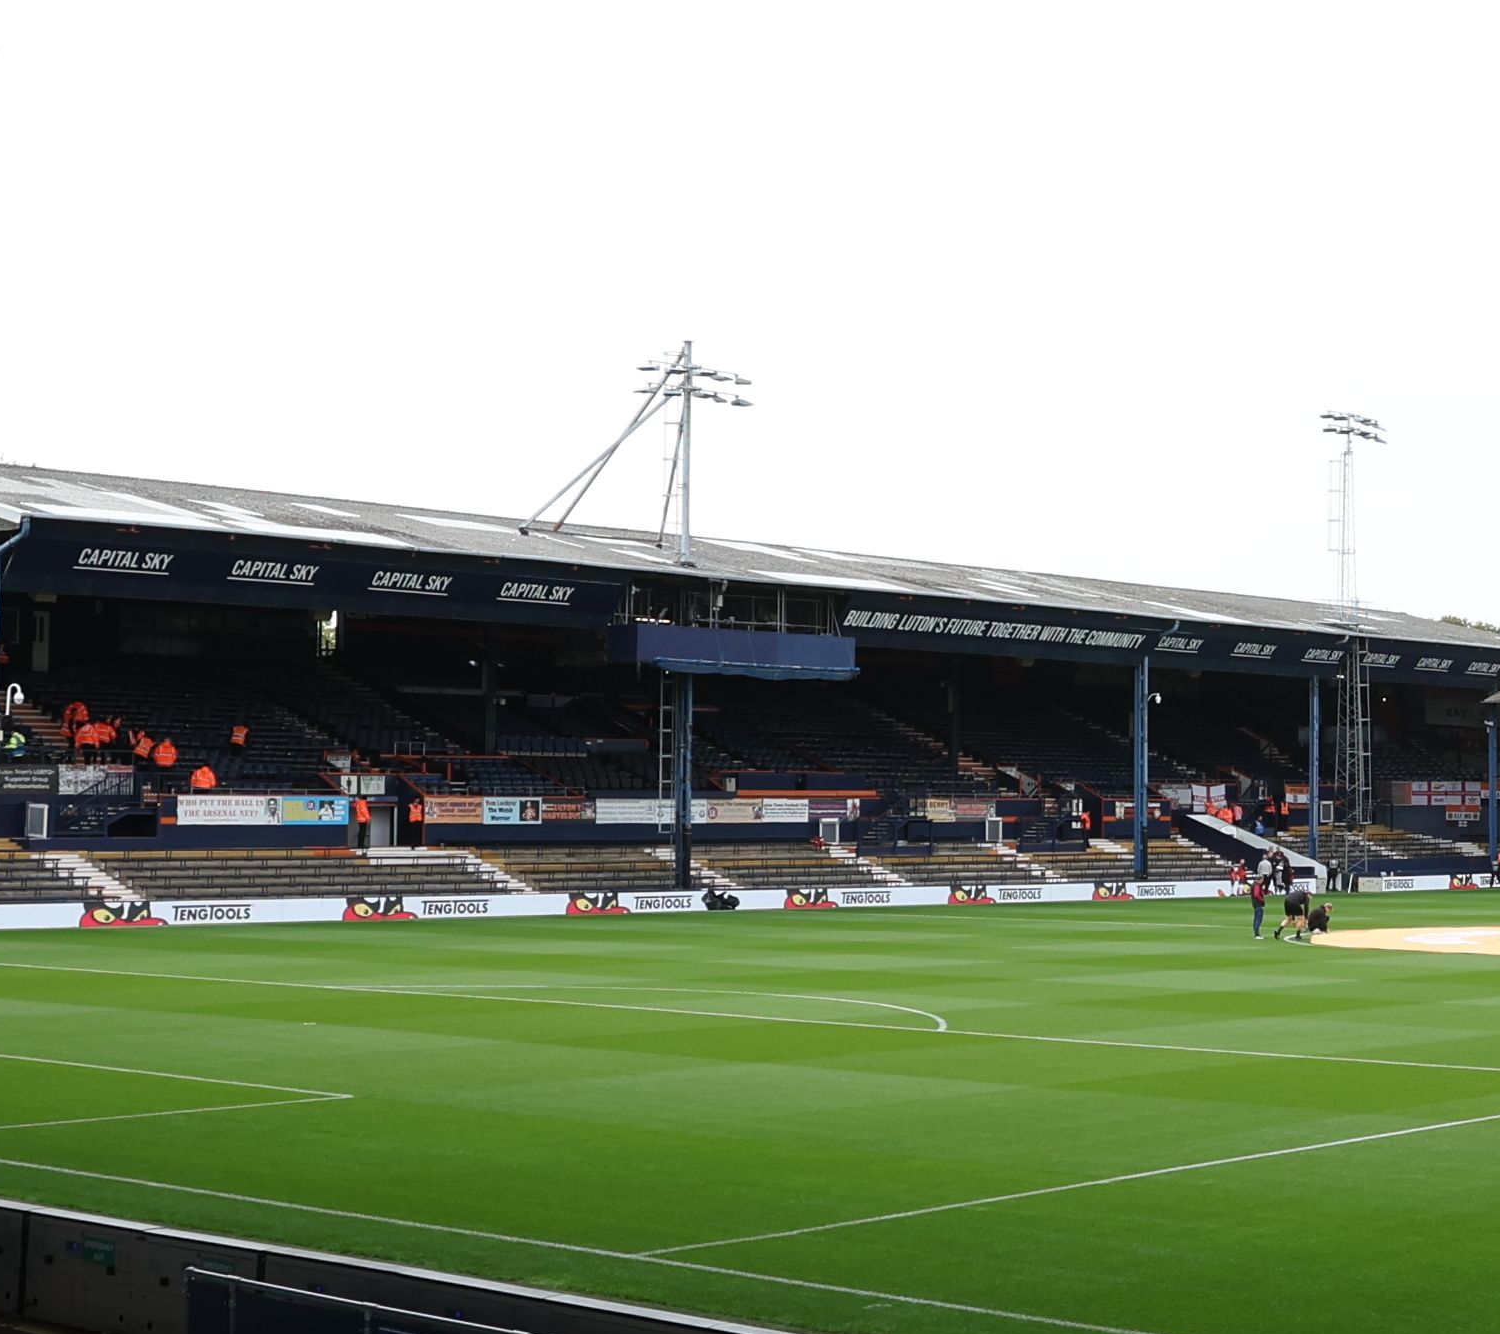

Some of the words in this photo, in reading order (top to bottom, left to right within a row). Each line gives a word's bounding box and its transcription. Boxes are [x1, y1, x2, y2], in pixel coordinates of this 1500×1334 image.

[78, 548, 138, 568] CAPITAL
[141, 553, 174, 570] SKY
[231, 560, 287, 579] CAPITAL
[290, 565, 319, 581] SKY
[372, 571, 423, 589] CAPITAL
[425, 576, 453, 591] SKY
[500, 582, 547, 599] CAPITAL
[549, 586, 575, 601] SKY
[843, 610, 899, 629] BUILDING
[898, 614, 947, 633] LUTON'S
[944, 618, 989, 637] FUTURE
[988, 621, 1041, 640] TOGETHER
[1038, 625, 1069, 643] WITH
[1067, 628, 1089, 646] THE
[1085, 630, 1147, 650] COMMUNITY
[1158, 636, 1190, 649] CAPITAL
[1189, 639, 1204, 650] SKY
[1233, 642, 1261, 655] CAPITAL
[1261, 645, 1278, 656] SKY
[1304, 648, 1330, 660] CAPITAL
[1329, 651, 1344, 661] SKY
[1386, 655, 1401, 665] SKY
[1416, 658, 1440, 668] CAPITAL
[1439, 660, 1453, 669] SKY
[1467, 662, 1489, 672] CAPITAL
[179, 799, 197, 807] WHO
[200, 799, 215, 807] PUT
[217, 799, 233, 807] THE
[235, 799, 254, 807] BALL
[184, 809, 200, 817] THE
[202, 809, 236, 817] ARSENAL
[841, 891, 891, 905] TENGTOOLS
[999, 888, 1042, 901] TENGTOOLS
[1137, 885, 1175, 898] TENGTOOLS
[422, 898, 489, 915] TENGTOOLS
[634, 895, 692, 910] TENGTOOLS
[172, 904, 252, 922] TENGTOOLS
